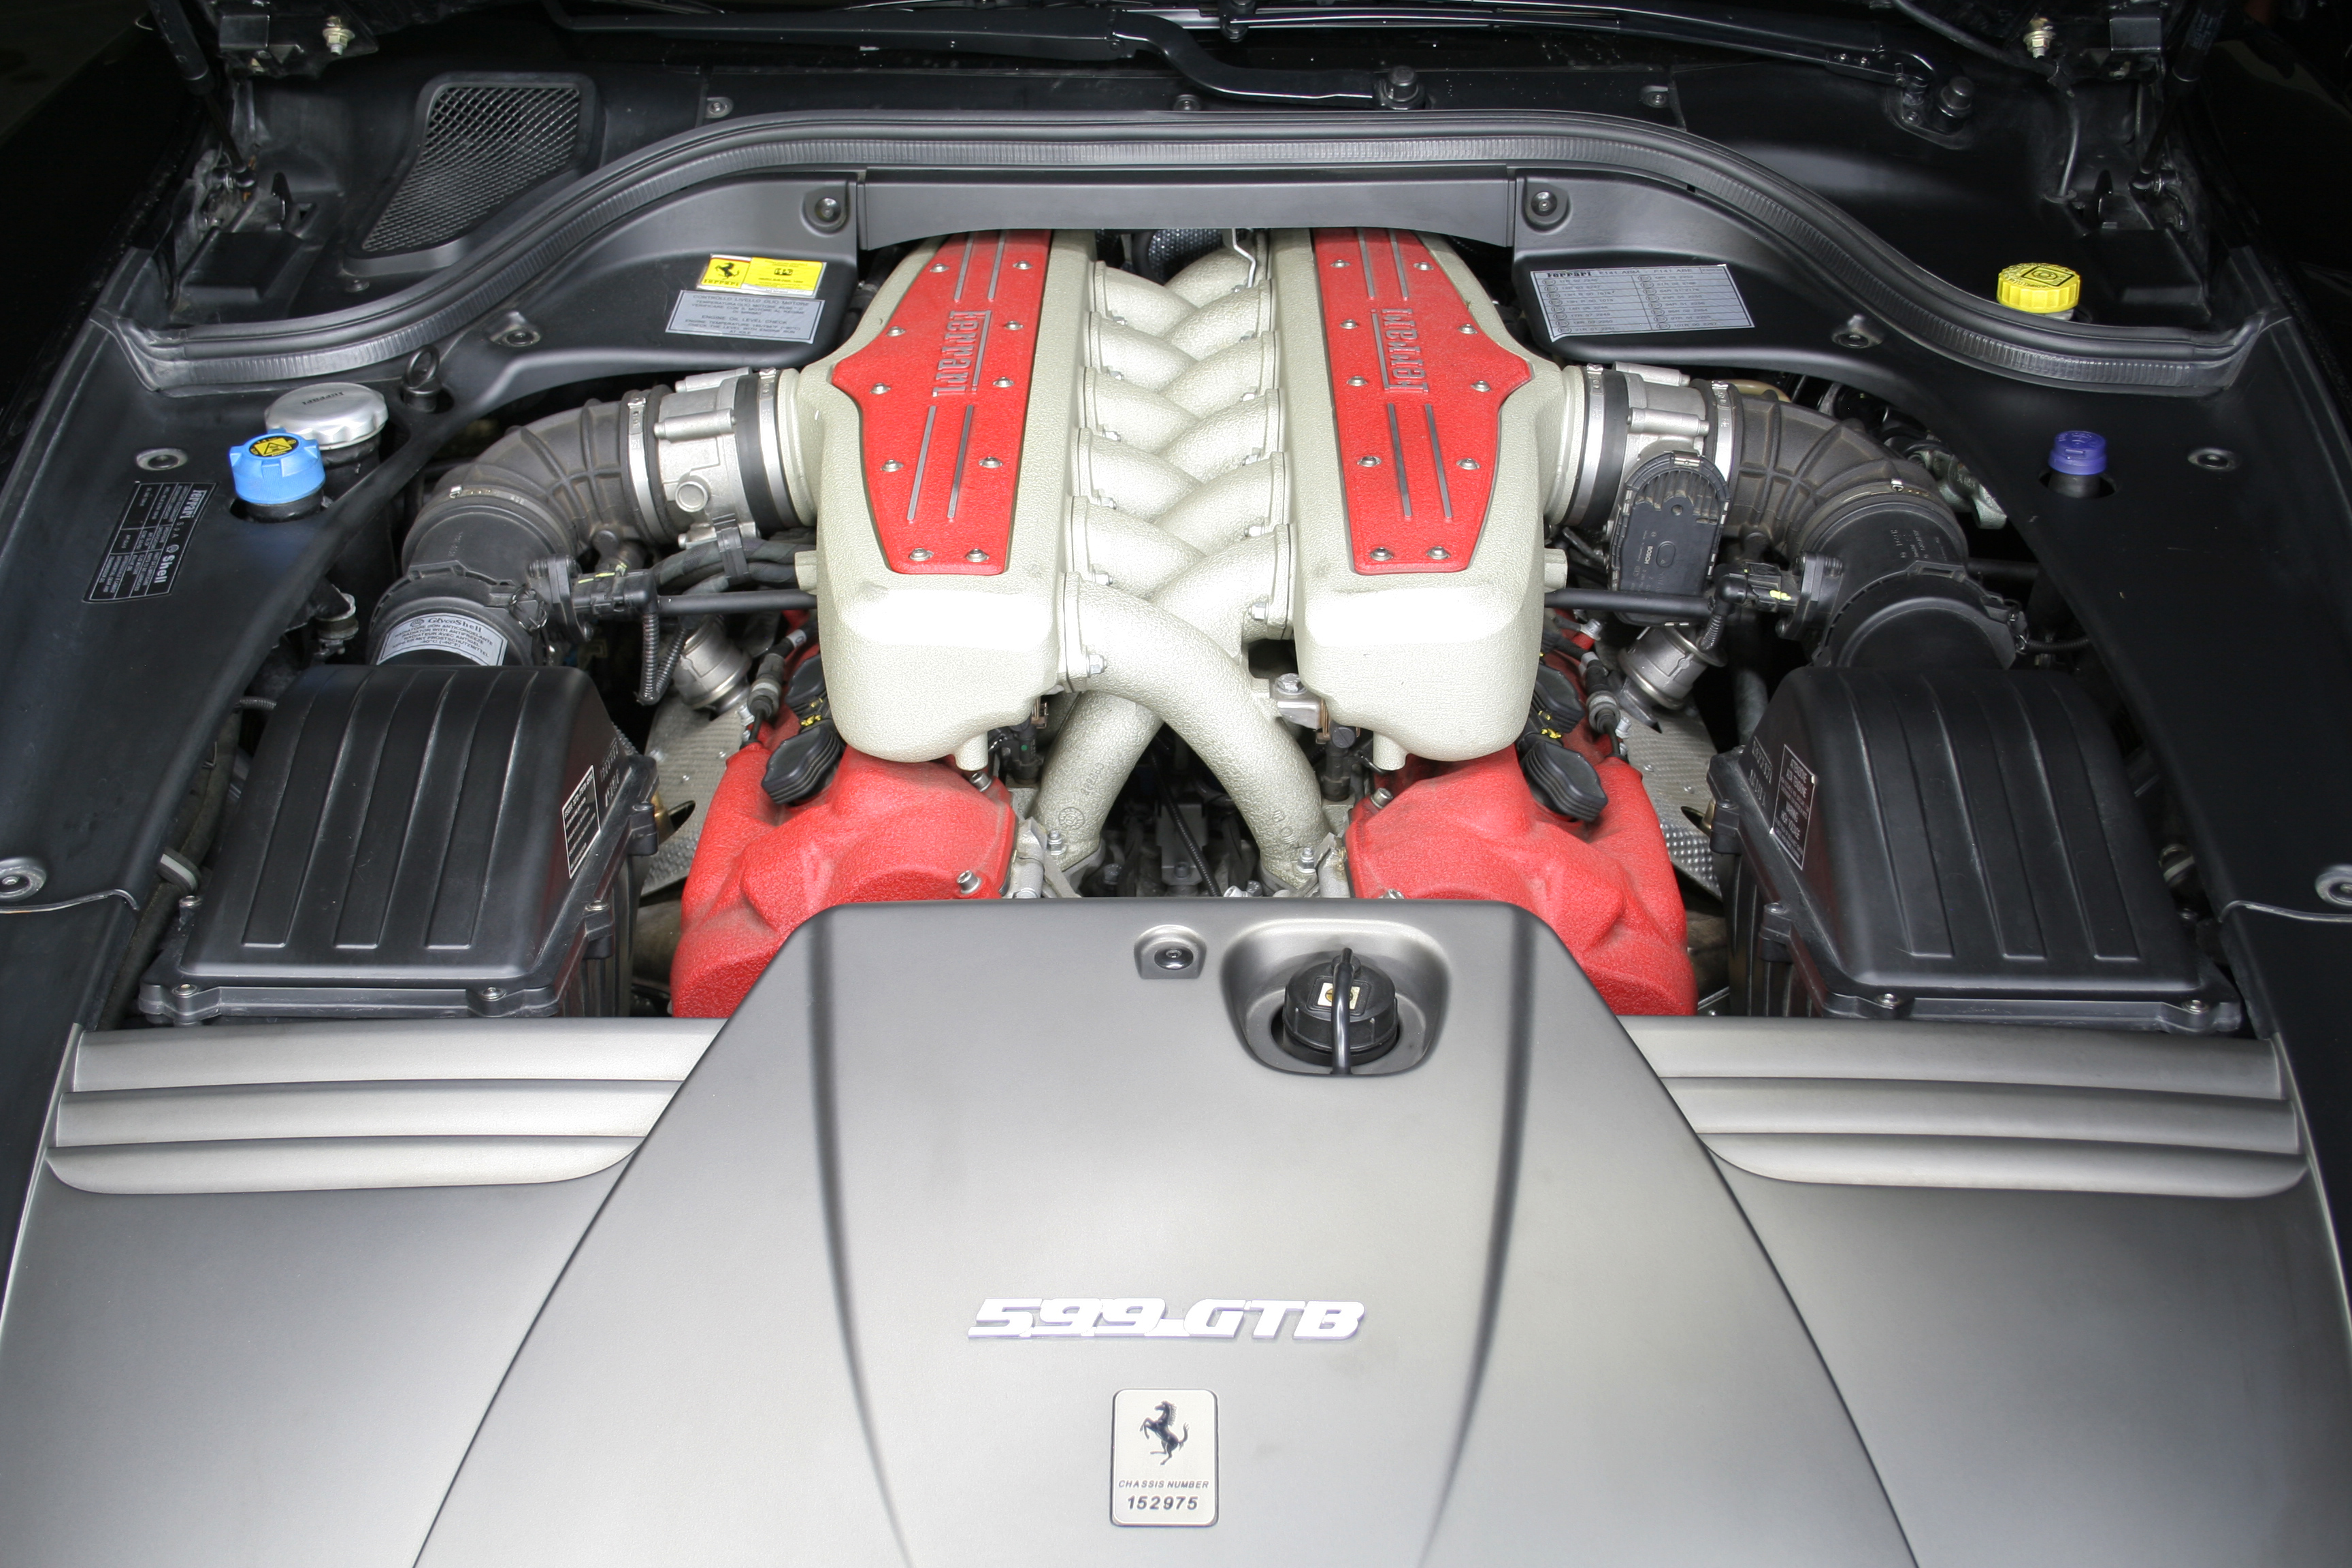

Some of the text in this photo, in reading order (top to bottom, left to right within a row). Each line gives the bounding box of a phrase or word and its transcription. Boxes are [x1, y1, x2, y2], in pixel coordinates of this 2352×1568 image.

[178, 489, 208, 519] Ferrari
[1644, 546, 1653, 564] BOSCH
[152, 555, 177, 583] Shell
[428, 618, 482, 632] GlycoShell
[395, 625, 425, 638] RADIATORE
[442, 625, 493, 646] ANTICONGELANTE
[402, 629, 431, 638] RADIATOR
[449, 630, 483, 644] ANTIFREEZE
[456, 636, 480, 647] ANTIGEL
[427, 636, 489, 657] FROSTSCHUTZMITTEL
[968, 1297, 1365, 1341] 599 GTB
[1118, 1480, 1210, 1489] CHASSIS NUMBER
[1127, 1494, 1198, 1512] 152975
